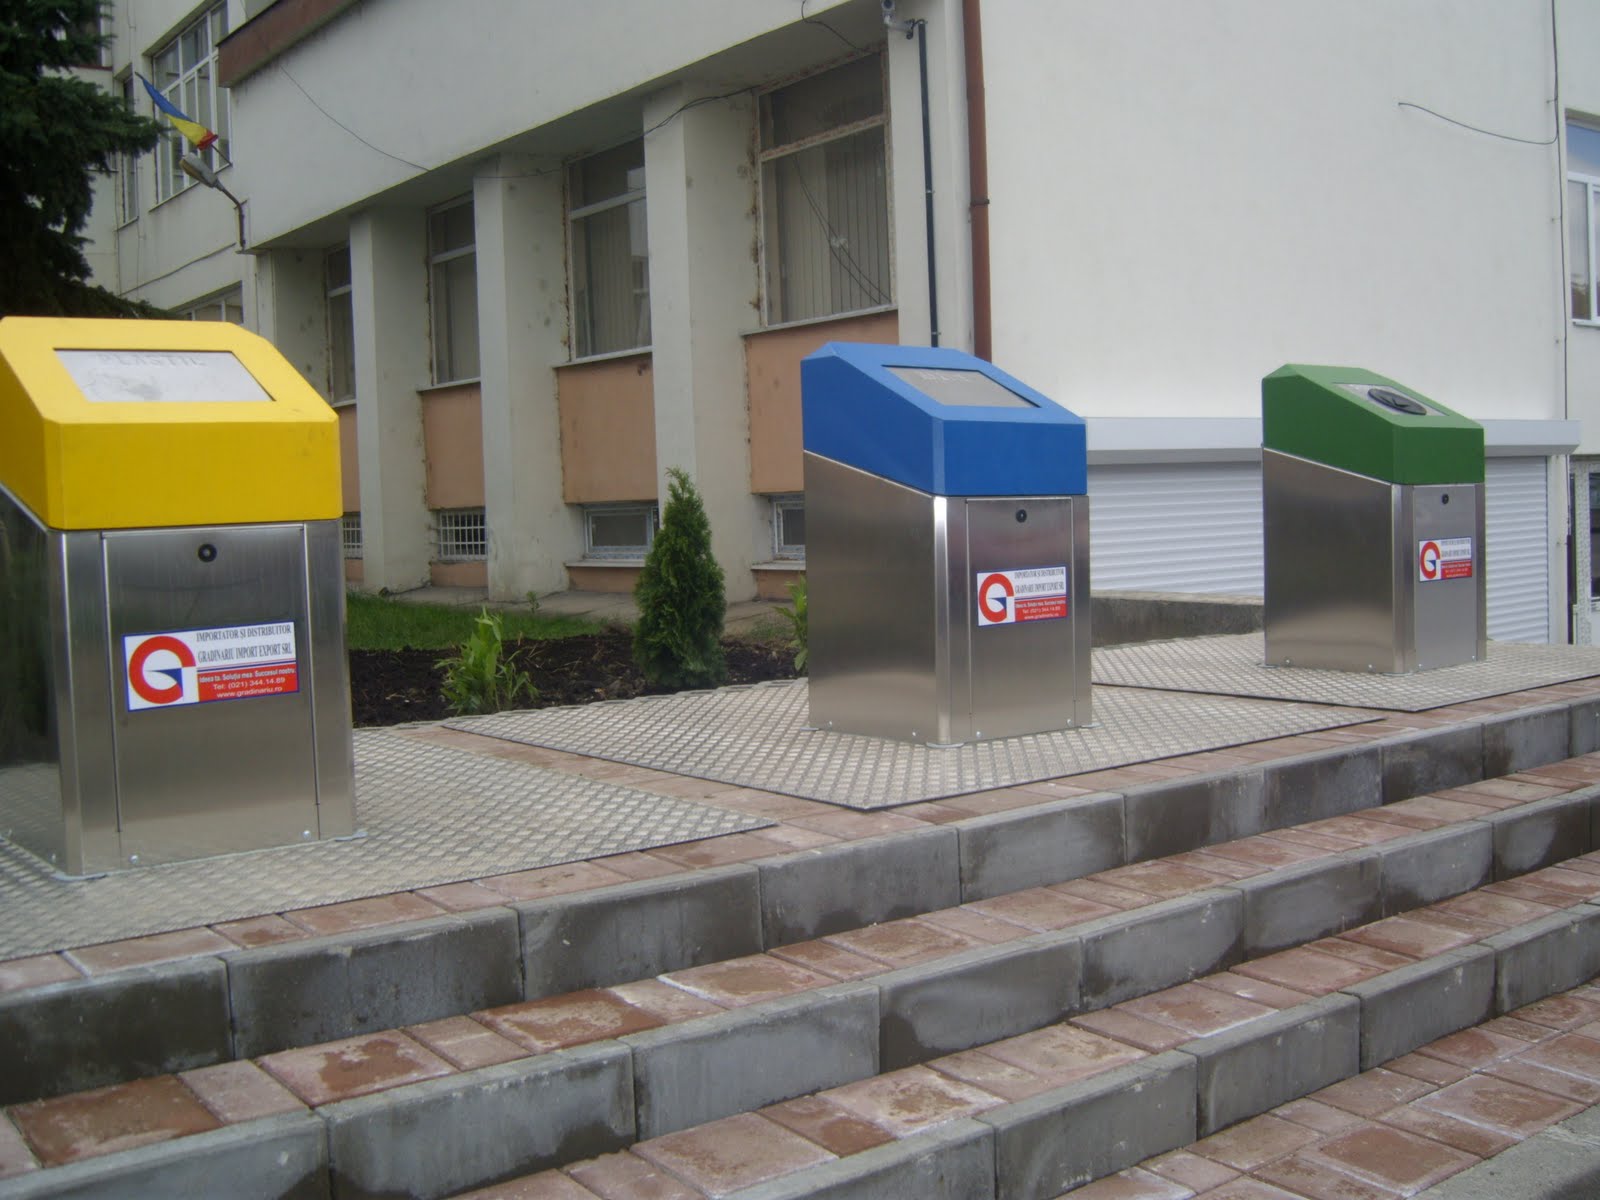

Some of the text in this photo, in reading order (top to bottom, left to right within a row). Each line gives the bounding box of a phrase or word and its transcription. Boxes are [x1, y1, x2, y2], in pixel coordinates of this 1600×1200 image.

[196, 630, 239, 641] IMPORTATOR
[247, 624, 291, 637] DISTRIBUITOR
[198, 642, 293, 662] GRADINARIU IMPORT EXPORT SRL
[228, 681, 248, 689] (021)
[249, 677, 286, 687] 344.14.89
[216, 687, 283, 698] www.gradinariu.ro
